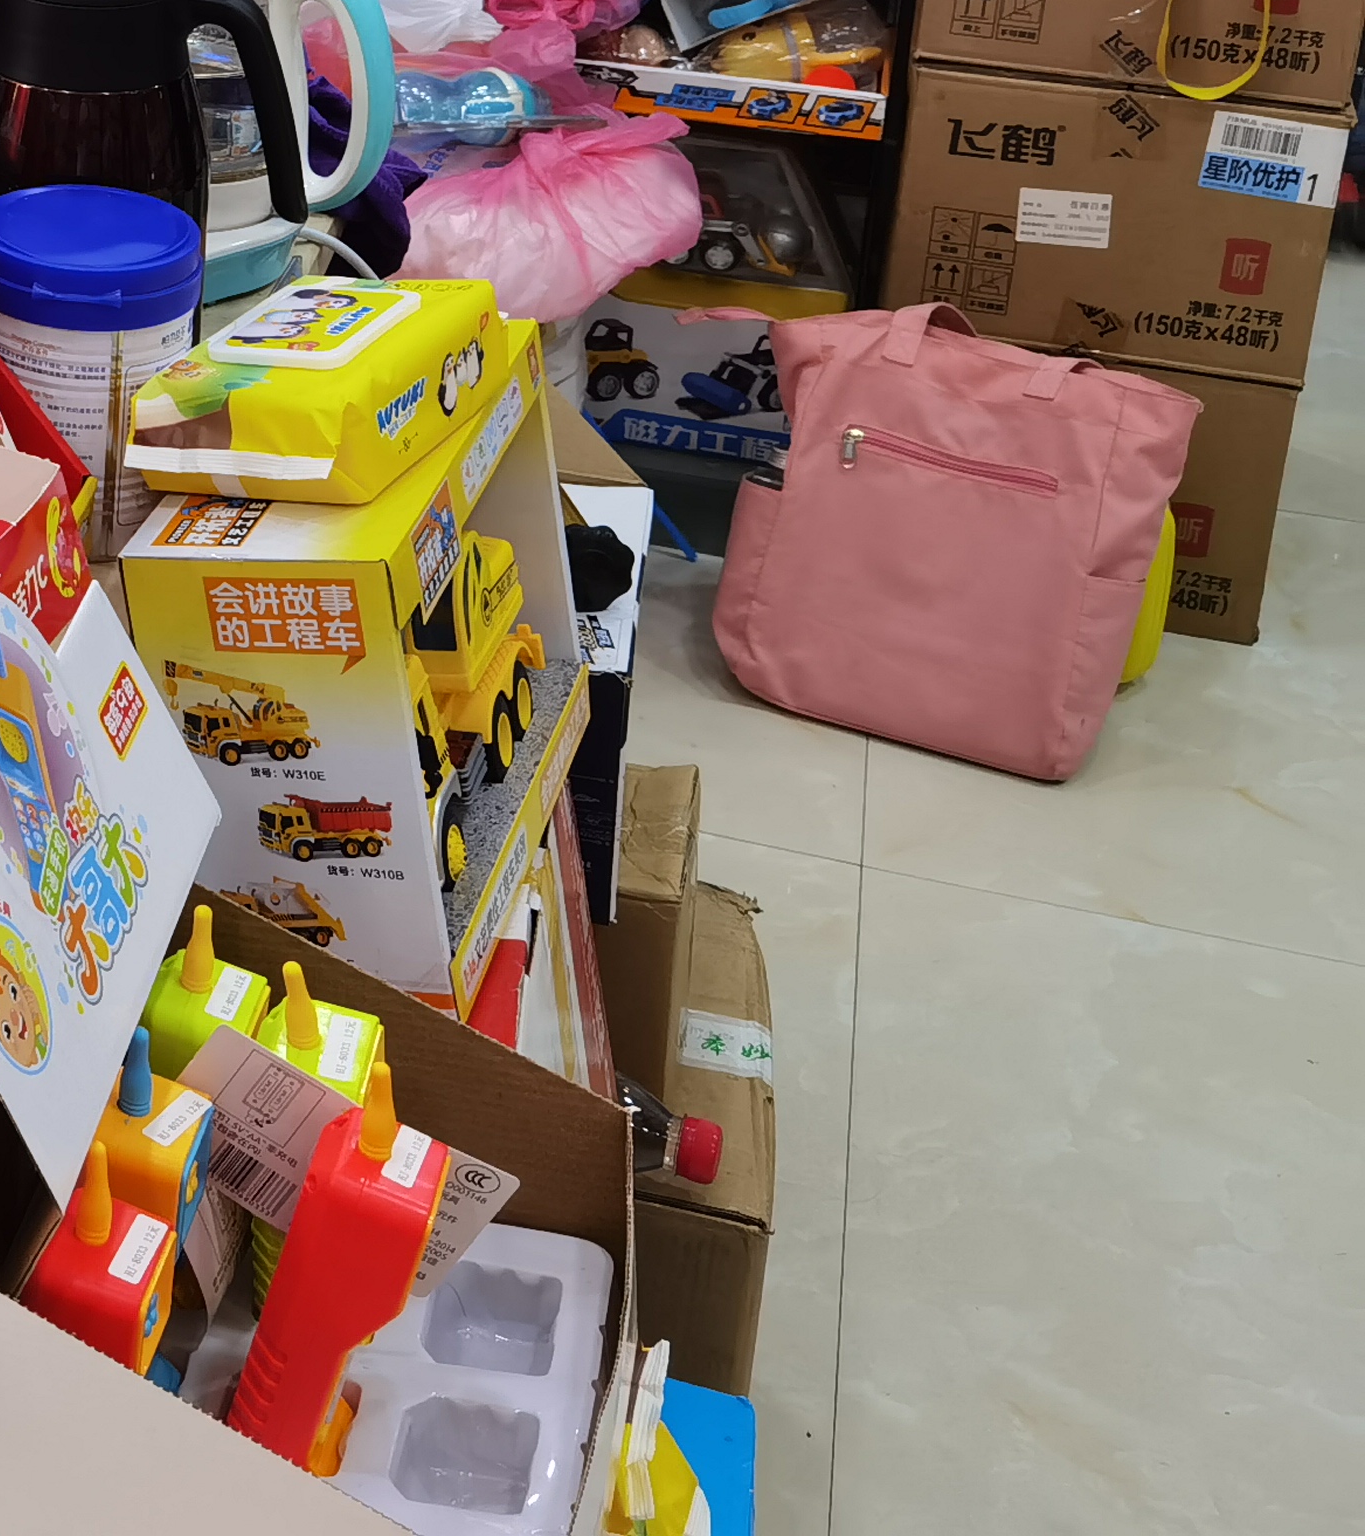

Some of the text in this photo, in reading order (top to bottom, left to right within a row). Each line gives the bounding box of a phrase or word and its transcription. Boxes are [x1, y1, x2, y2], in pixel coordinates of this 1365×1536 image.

[947, 116, 1058, 166] 飞鹤
[1202, 153, 1302, 193] 星阶优护
[1231, 252, 1258, 281] 听
[1133, 311, 1280, 353] (150克x48听)
[208, 580, 354, 616] 会讲故事
[215, 617, 363, 653] 的工程车
[42, 830, 68, 914] 卡通手机
[62, 816, 149, 1006] 大哥大
